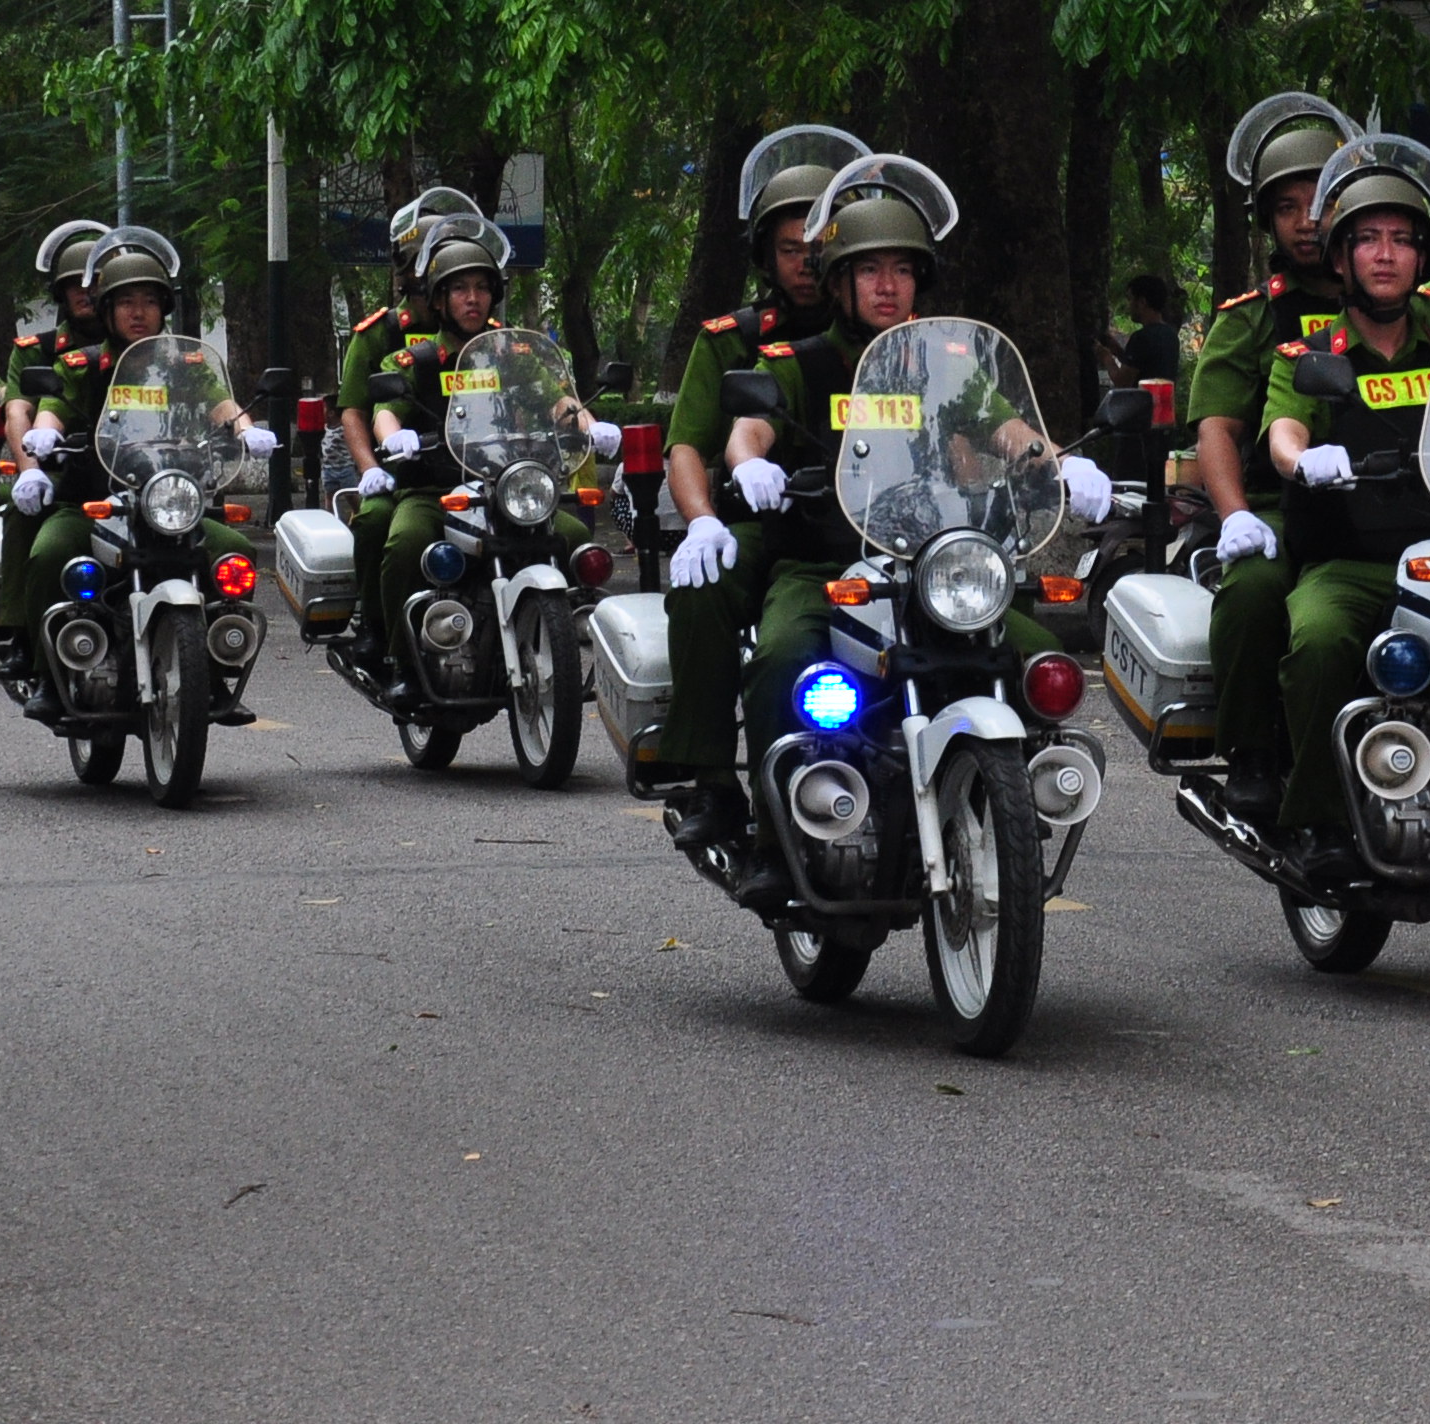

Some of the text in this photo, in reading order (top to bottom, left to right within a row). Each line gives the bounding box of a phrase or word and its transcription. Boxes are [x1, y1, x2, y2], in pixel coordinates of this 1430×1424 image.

[112, 387, 164, 405] CS 113
[445, 375, 497, 391] CS 113
[1365, 377, 1397, 403] CS
[837, 399, 913, 426] CS 113
[1111, 630, 1148, 697] CSTT
